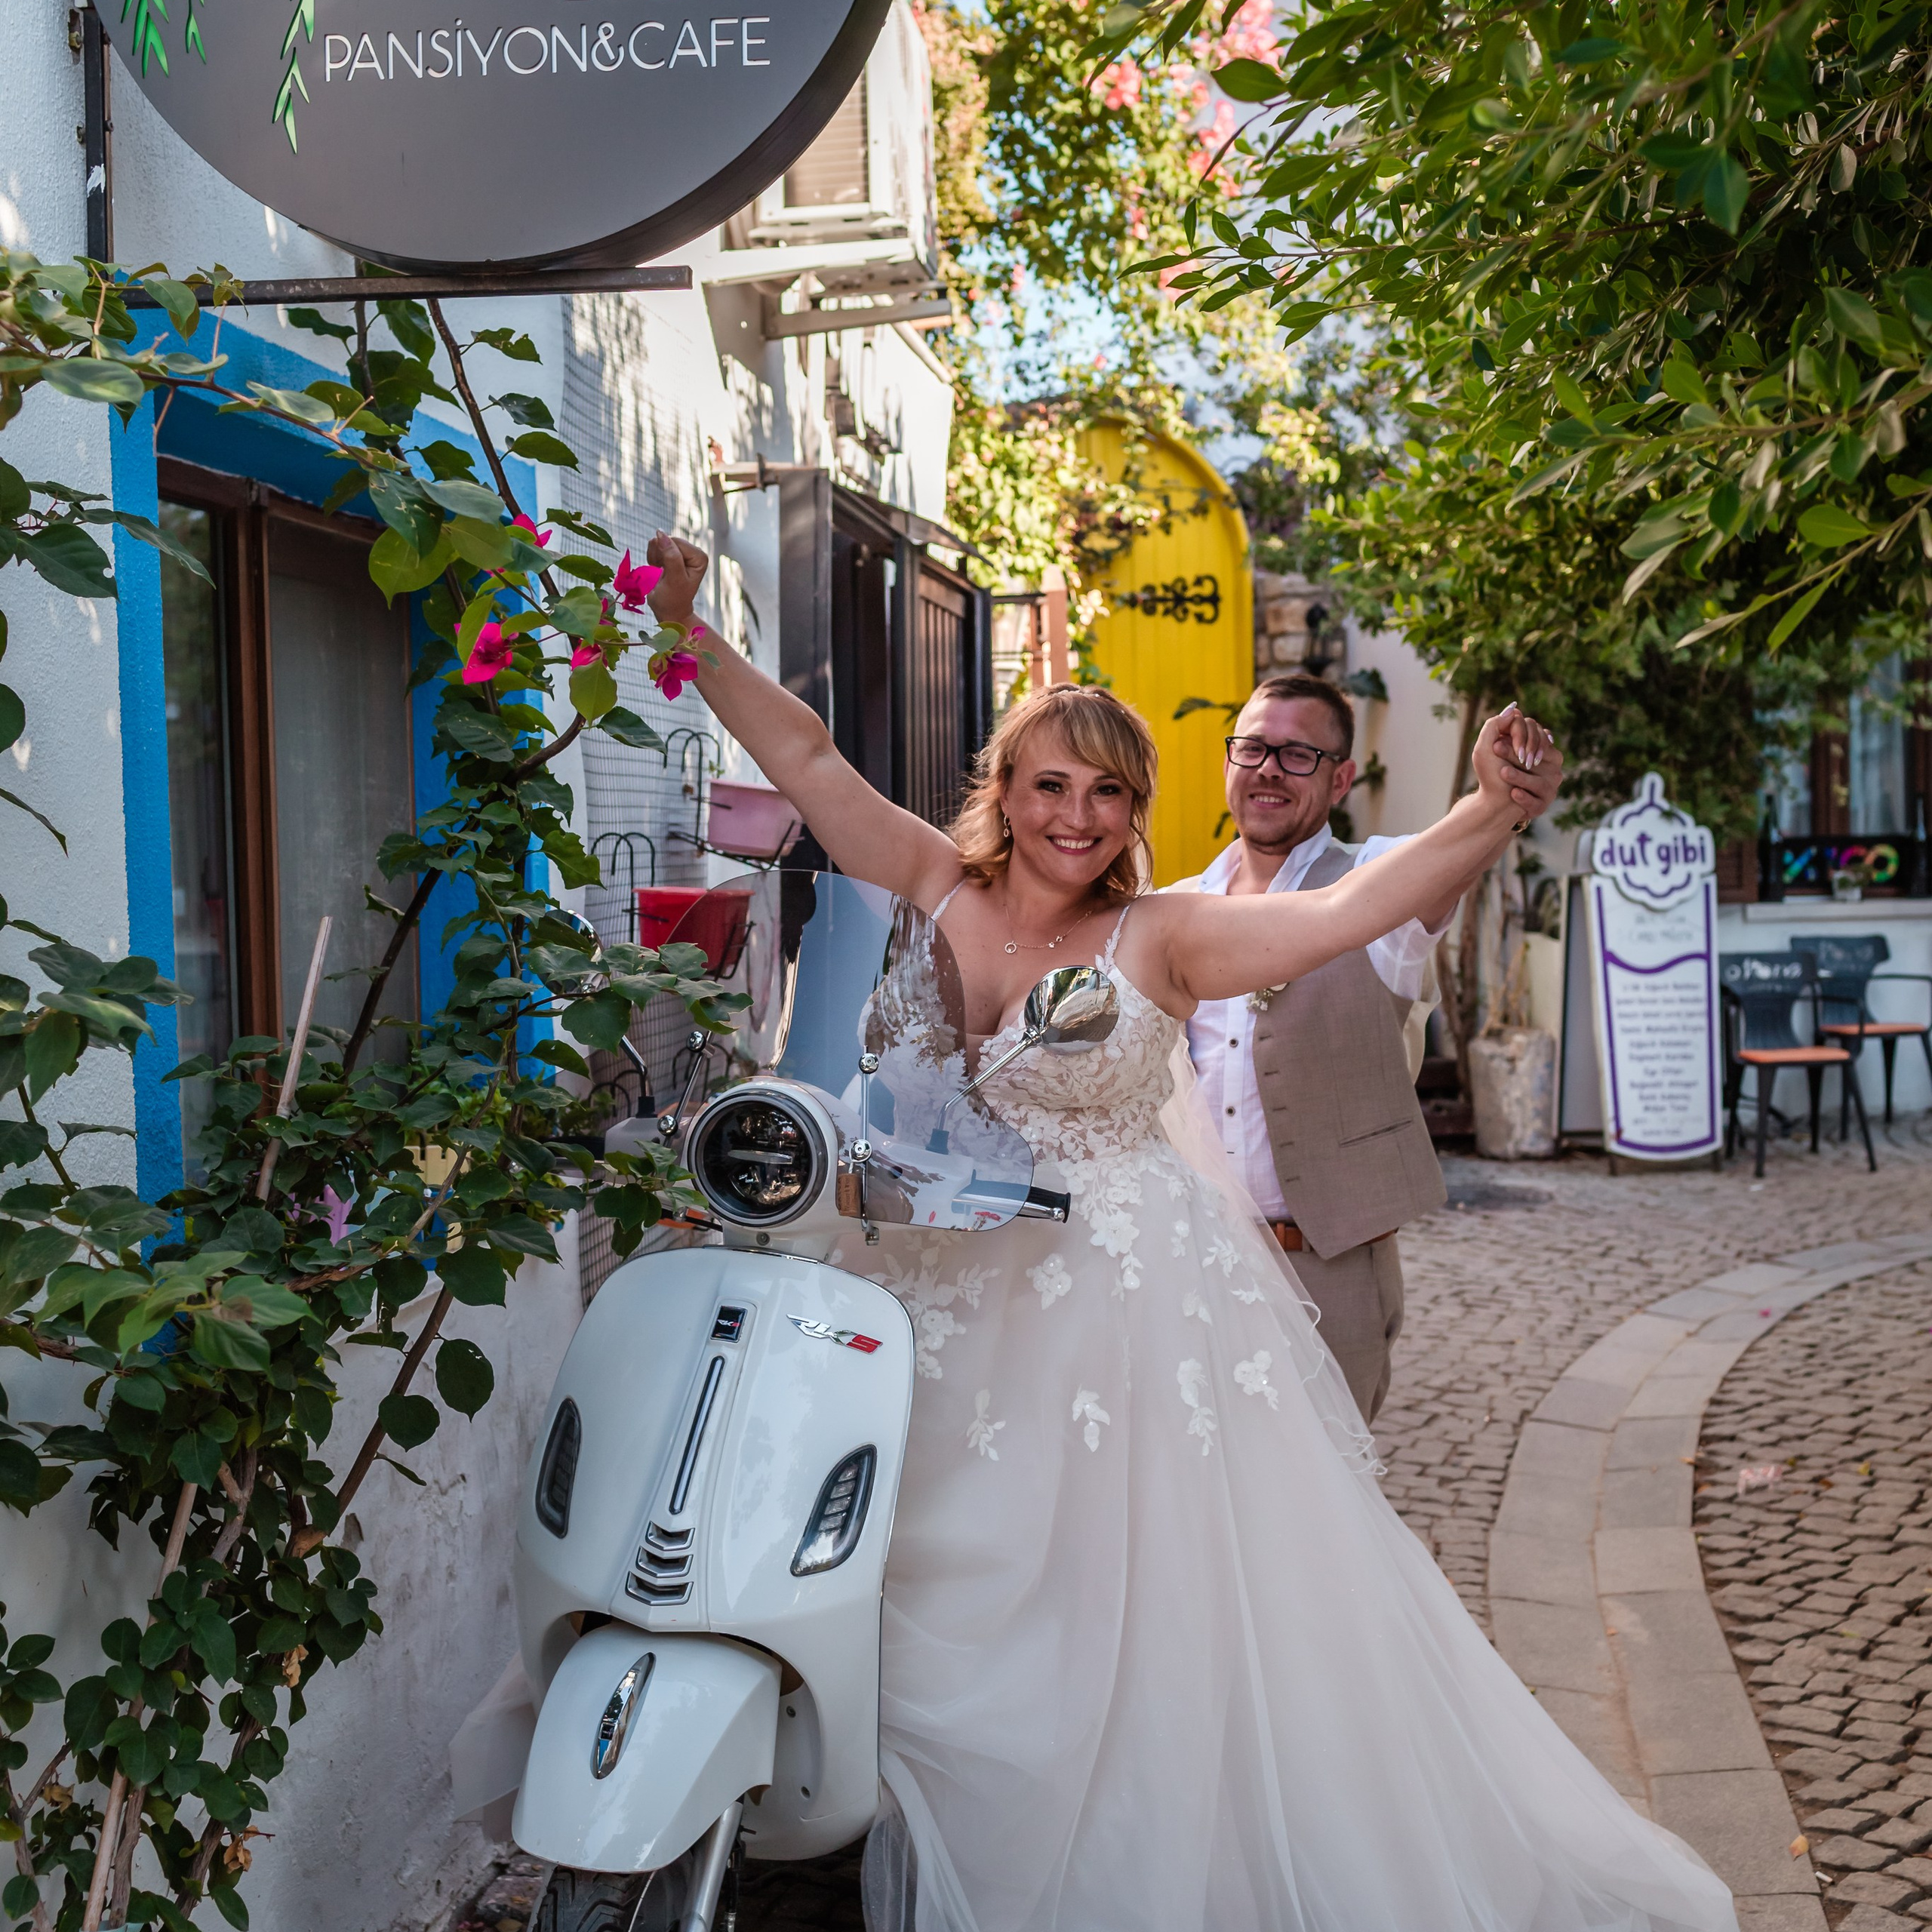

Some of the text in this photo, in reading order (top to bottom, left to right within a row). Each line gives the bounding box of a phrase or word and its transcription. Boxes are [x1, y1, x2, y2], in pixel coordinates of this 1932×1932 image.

[325, 17, 771, 82] PANSİYON&CAFE
[1601, 832, 1706, 875] dut gibi
